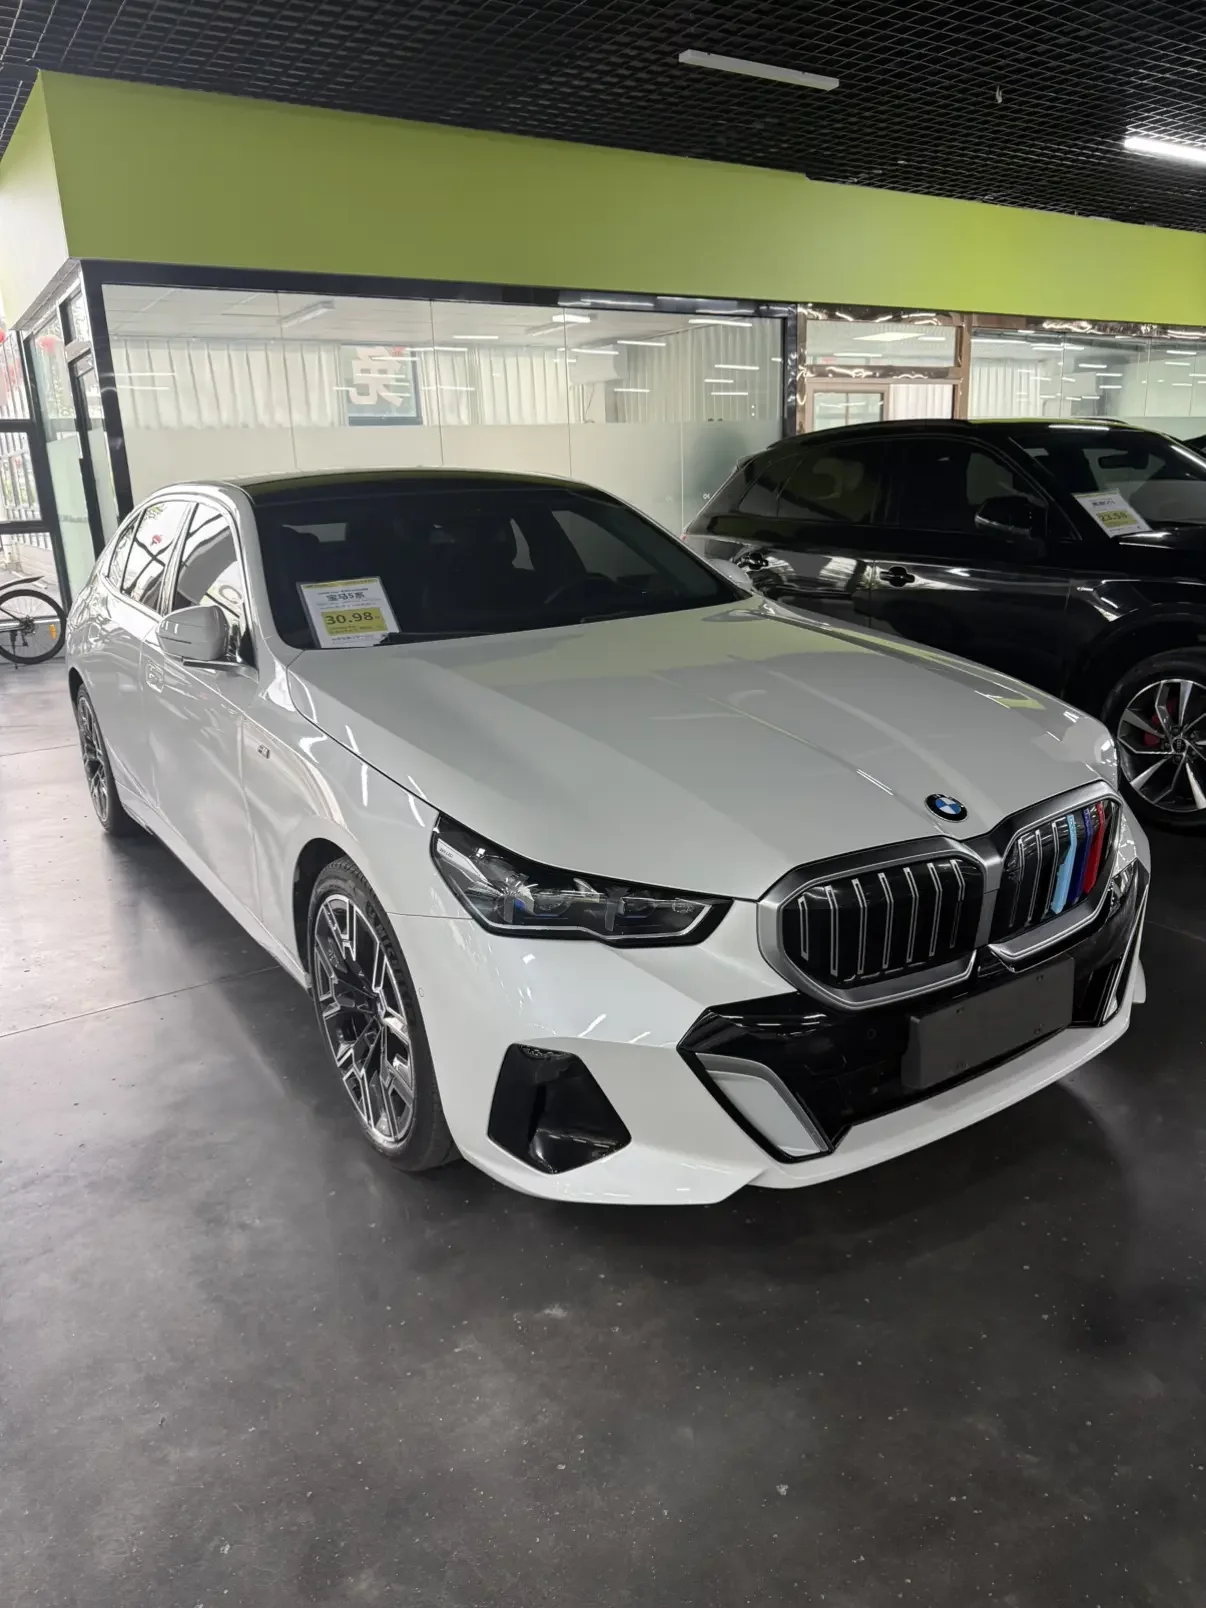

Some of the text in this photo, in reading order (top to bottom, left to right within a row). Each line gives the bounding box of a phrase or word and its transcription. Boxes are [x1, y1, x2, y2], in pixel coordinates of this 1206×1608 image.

[326, 592, 365, 601] 宝马5系
[325, 612, 374, 625] 30.98
